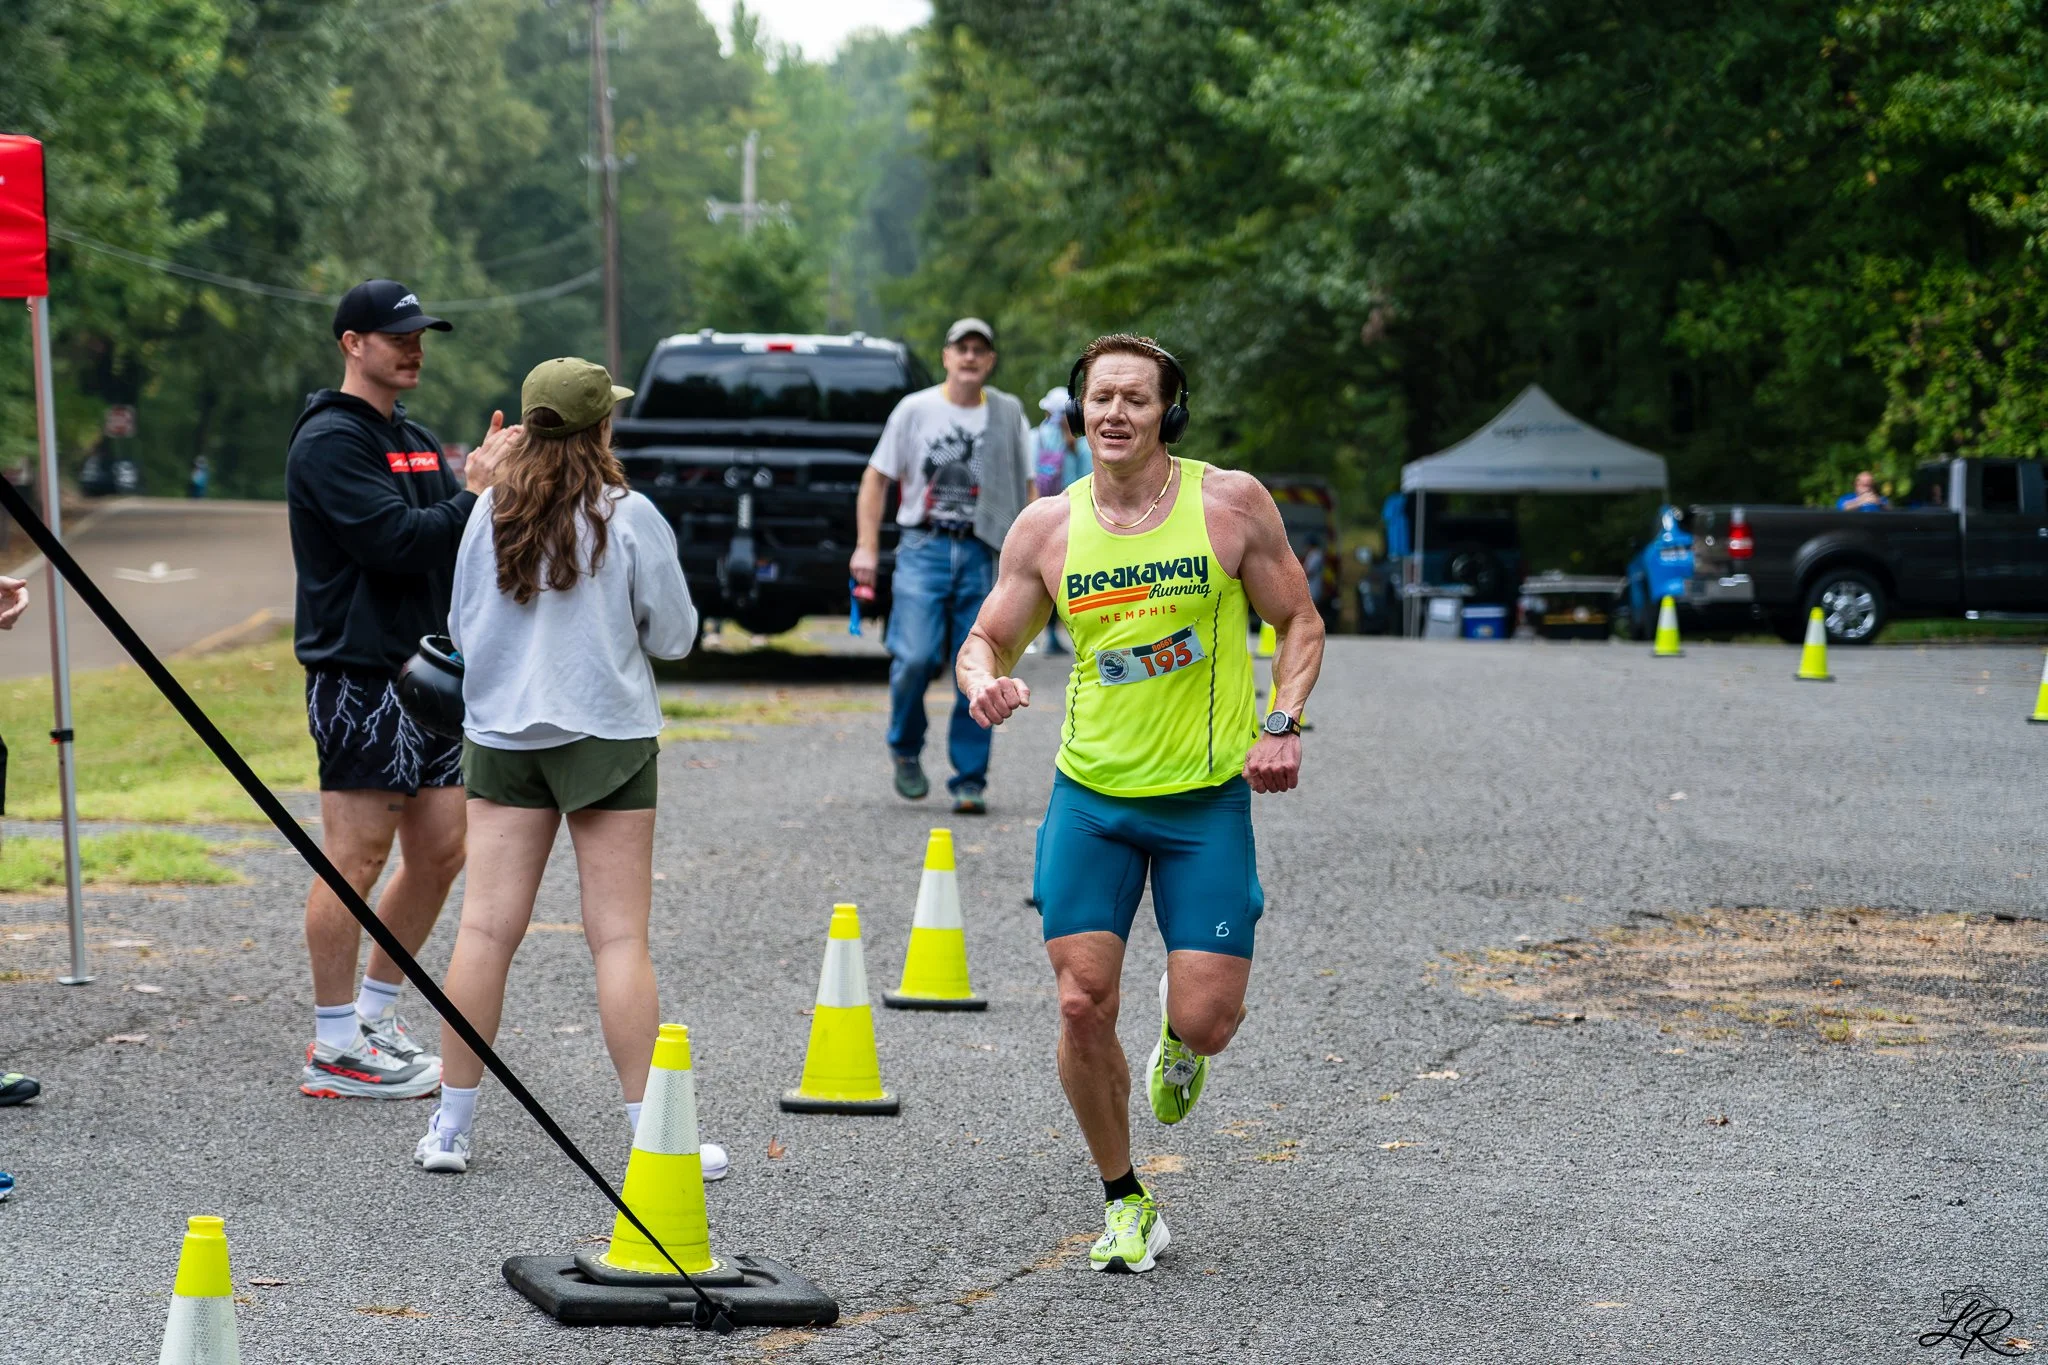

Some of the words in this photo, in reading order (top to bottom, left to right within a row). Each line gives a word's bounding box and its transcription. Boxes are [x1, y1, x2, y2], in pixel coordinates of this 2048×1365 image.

[1067, 555, 1209, 599] Breakaway
[1149, 580, 1211, 598] Running
[1100, 604, 1177, 624] MEMPHIS
[1140, 641, 1192, 677] 195
